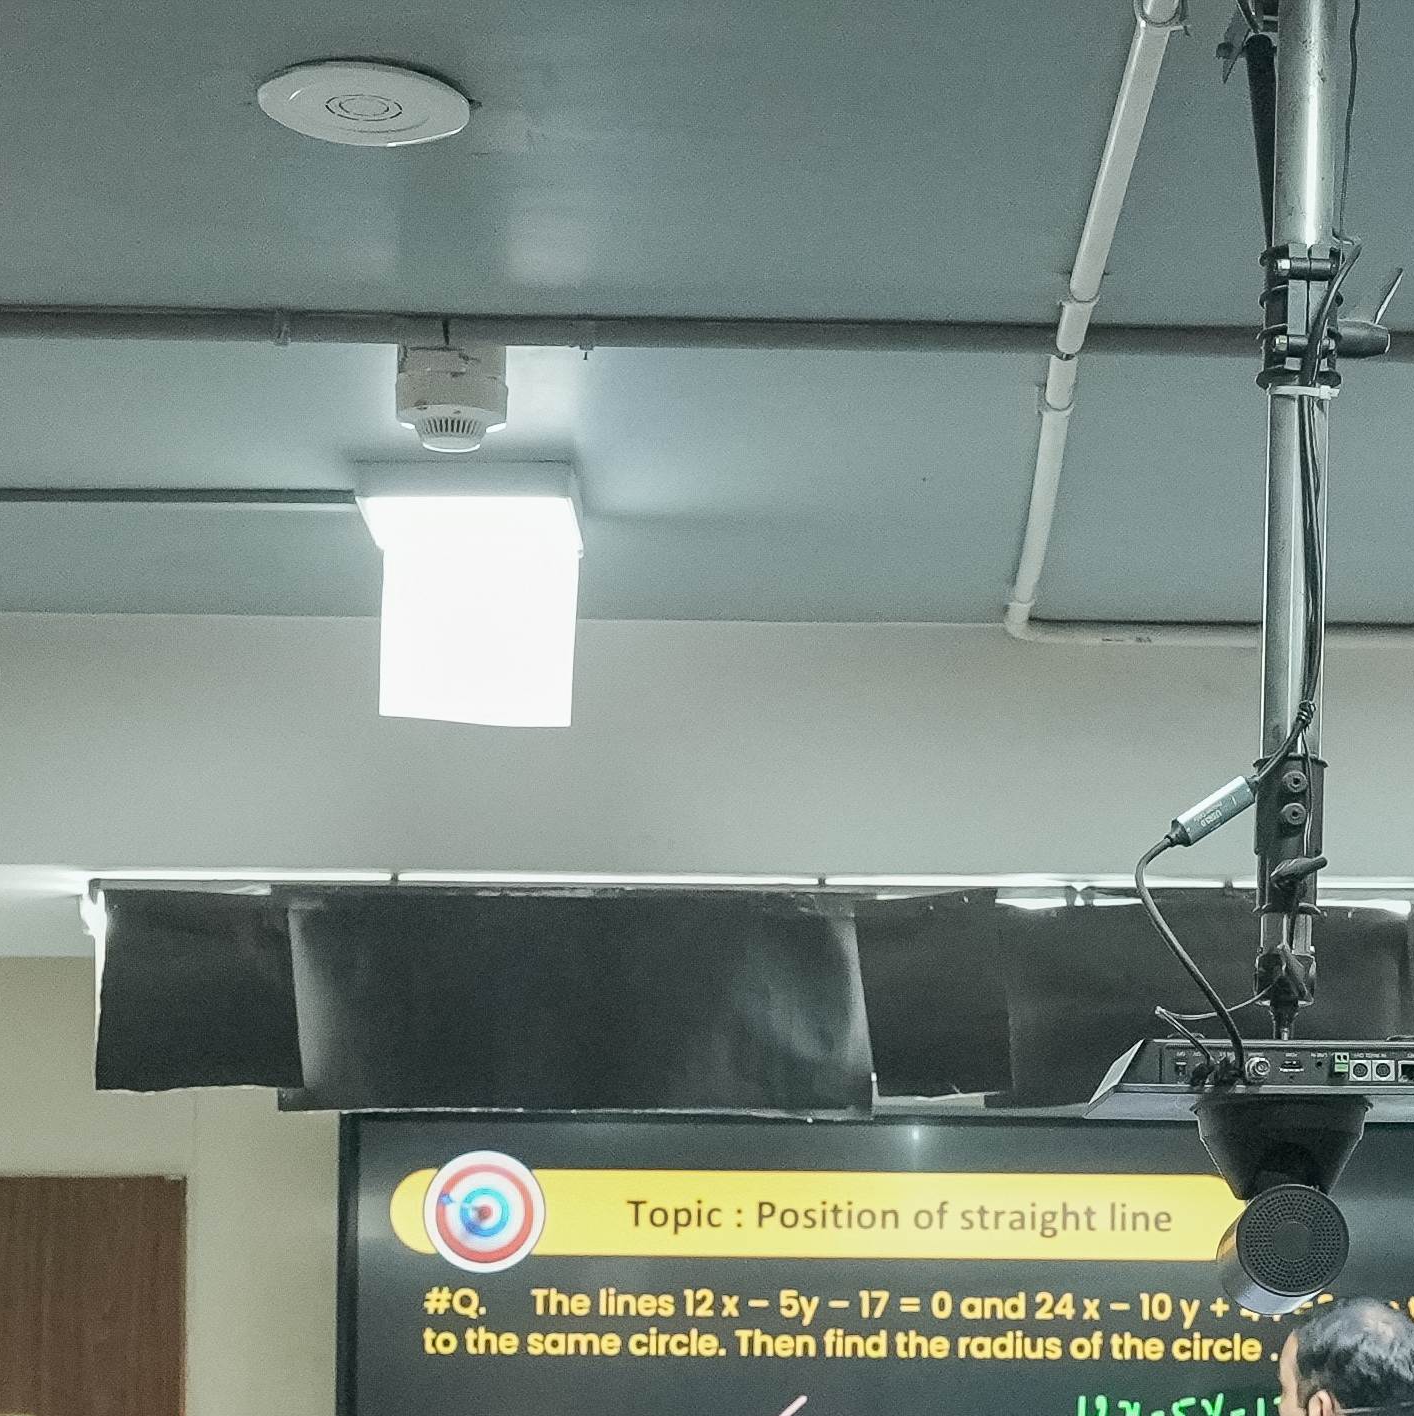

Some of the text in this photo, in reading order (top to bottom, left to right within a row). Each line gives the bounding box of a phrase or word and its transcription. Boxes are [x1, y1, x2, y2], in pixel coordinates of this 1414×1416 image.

[626, 1200, 723, 1235] Topic
[757, 1201, 900, 1231] Position
[914, 1201, 951, 1231] of
[960, 1202, 1097, 1238] straight
[1109, 1202, 1173, 1232] line
[423, 1286, 487, 1320] #Q.
[531, 1287, 591, 1317] The
[599, 1287, 676, 1317] lines
[683, 1288, 715, 1318] 12
[721, 1295, 740, 1318] x
[779, 1289, 819, 1326] 5y
[859, 1289, 890, 1319] 17
[900, 1296, 921, 1314] =
[931, 1290, 952, 1320] 0
[959, 1291, 1026, 1321] and
[1034, 1292, 1075, 1321] 24
[1083, 1297, 1100, 1321] x
[1139, 1292, 1173, 1322] 10
[1179, 1298, 1201, 1329] y
[1210, 1298, 1229, 1318] +
[423, 1326, 458, 1356] to
[465, 1327, 519, 1356] the
[526, 1333, 622, 1357] same
[628, 1327, 727, 1357] circle.
[734, 1328, 817, 1358] Then
[823, 1328, 888, 1359] find
[895, 1329, 950, 1360] the
[957, 1330, 1063, 1361] radius
[1069, 1330, 1104, 1361] of
[1110, 1331, 1165, 1362] the
[1171, 1332, 1262, 1362] circle
